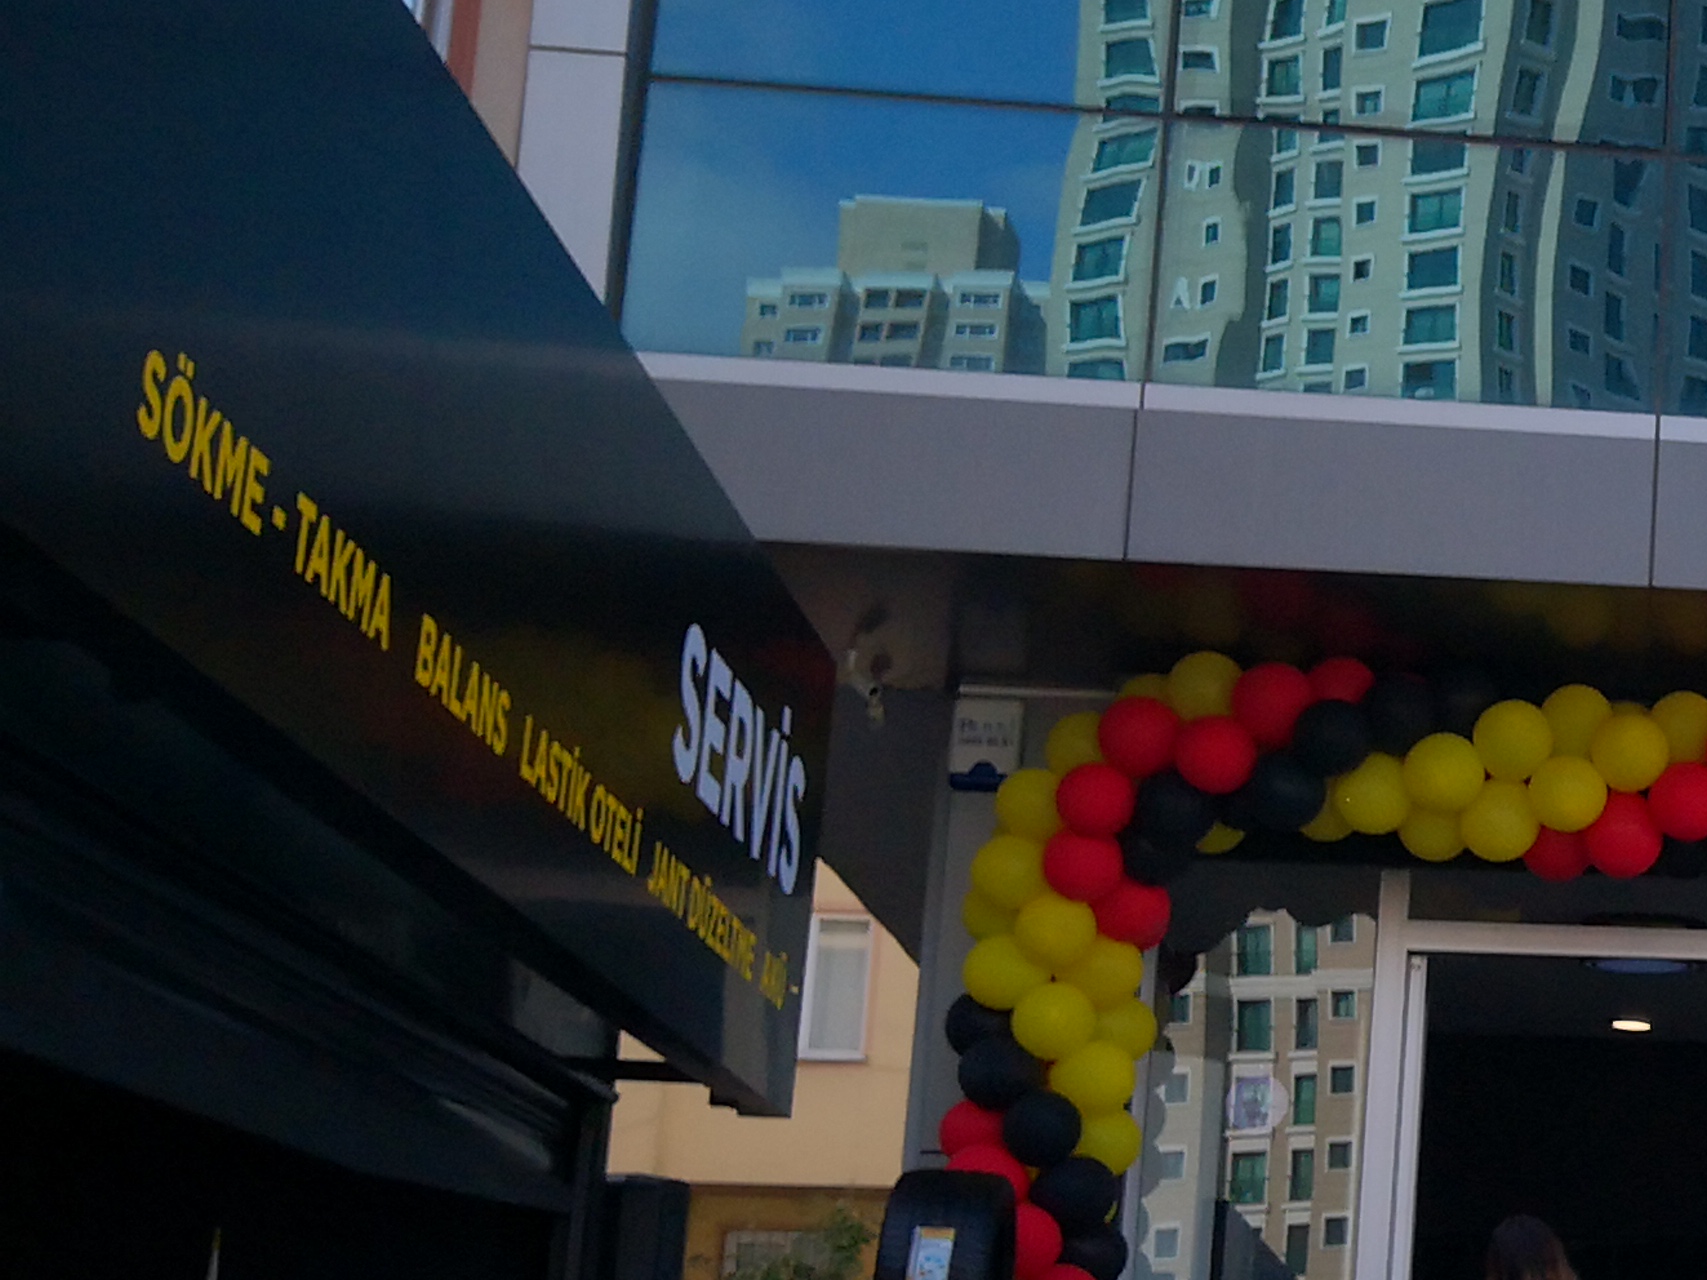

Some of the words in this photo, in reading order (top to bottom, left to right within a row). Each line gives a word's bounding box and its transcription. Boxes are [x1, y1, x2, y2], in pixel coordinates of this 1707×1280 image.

[137, 349, 271, 536] SÖKME
[295, 490, 391, 651] TAKMA
[415, 613, 512, 756] BALANS
[520, 714, 592, 832] LASTİK
[590, 784, 644, 876] OTELİ
[648, 839, 690, 919] JANT
[673, 623, 806, 896] SERVİS
